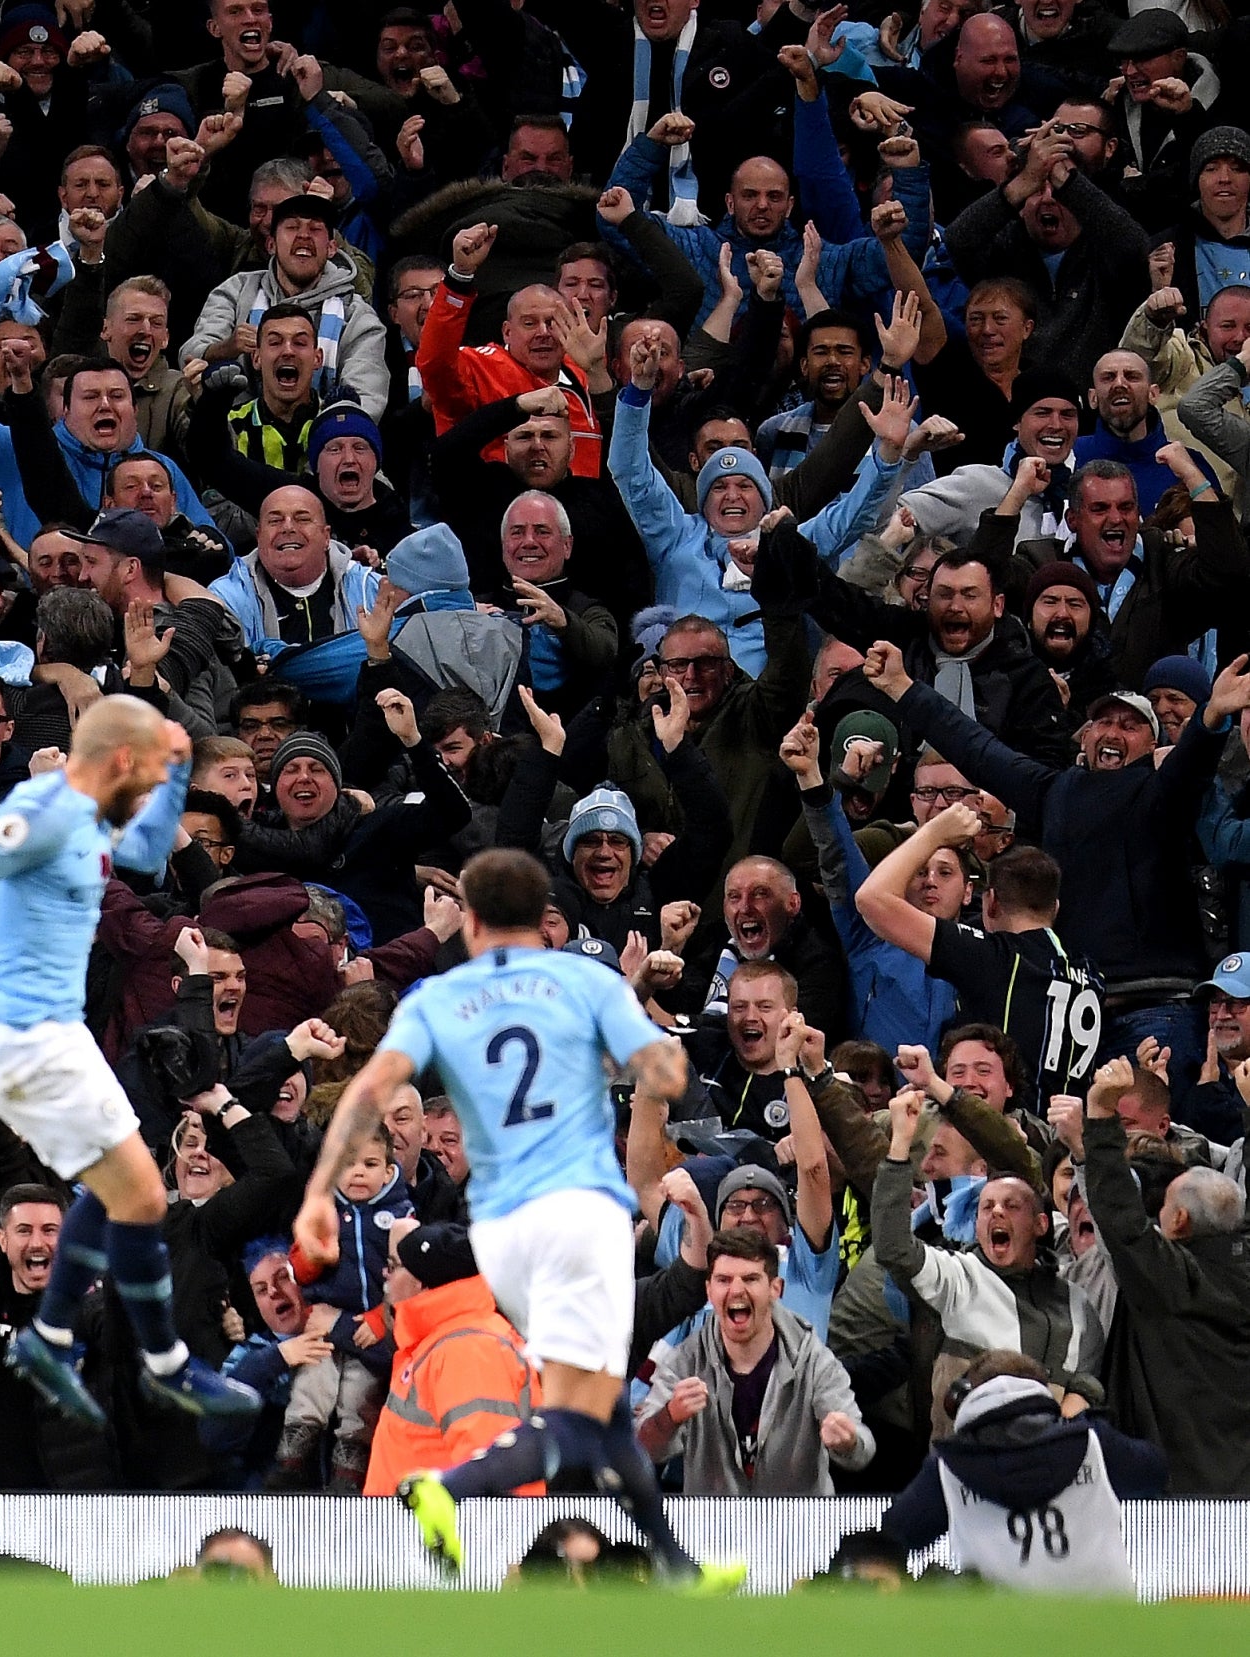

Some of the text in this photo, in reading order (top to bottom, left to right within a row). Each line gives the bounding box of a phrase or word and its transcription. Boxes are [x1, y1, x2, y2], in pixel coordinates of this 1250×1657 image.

[486, 1026, 555, 1129] 2
[1044, 979, 1102, 1079] 19
[1007, 1506, 1070, 1567] 98
